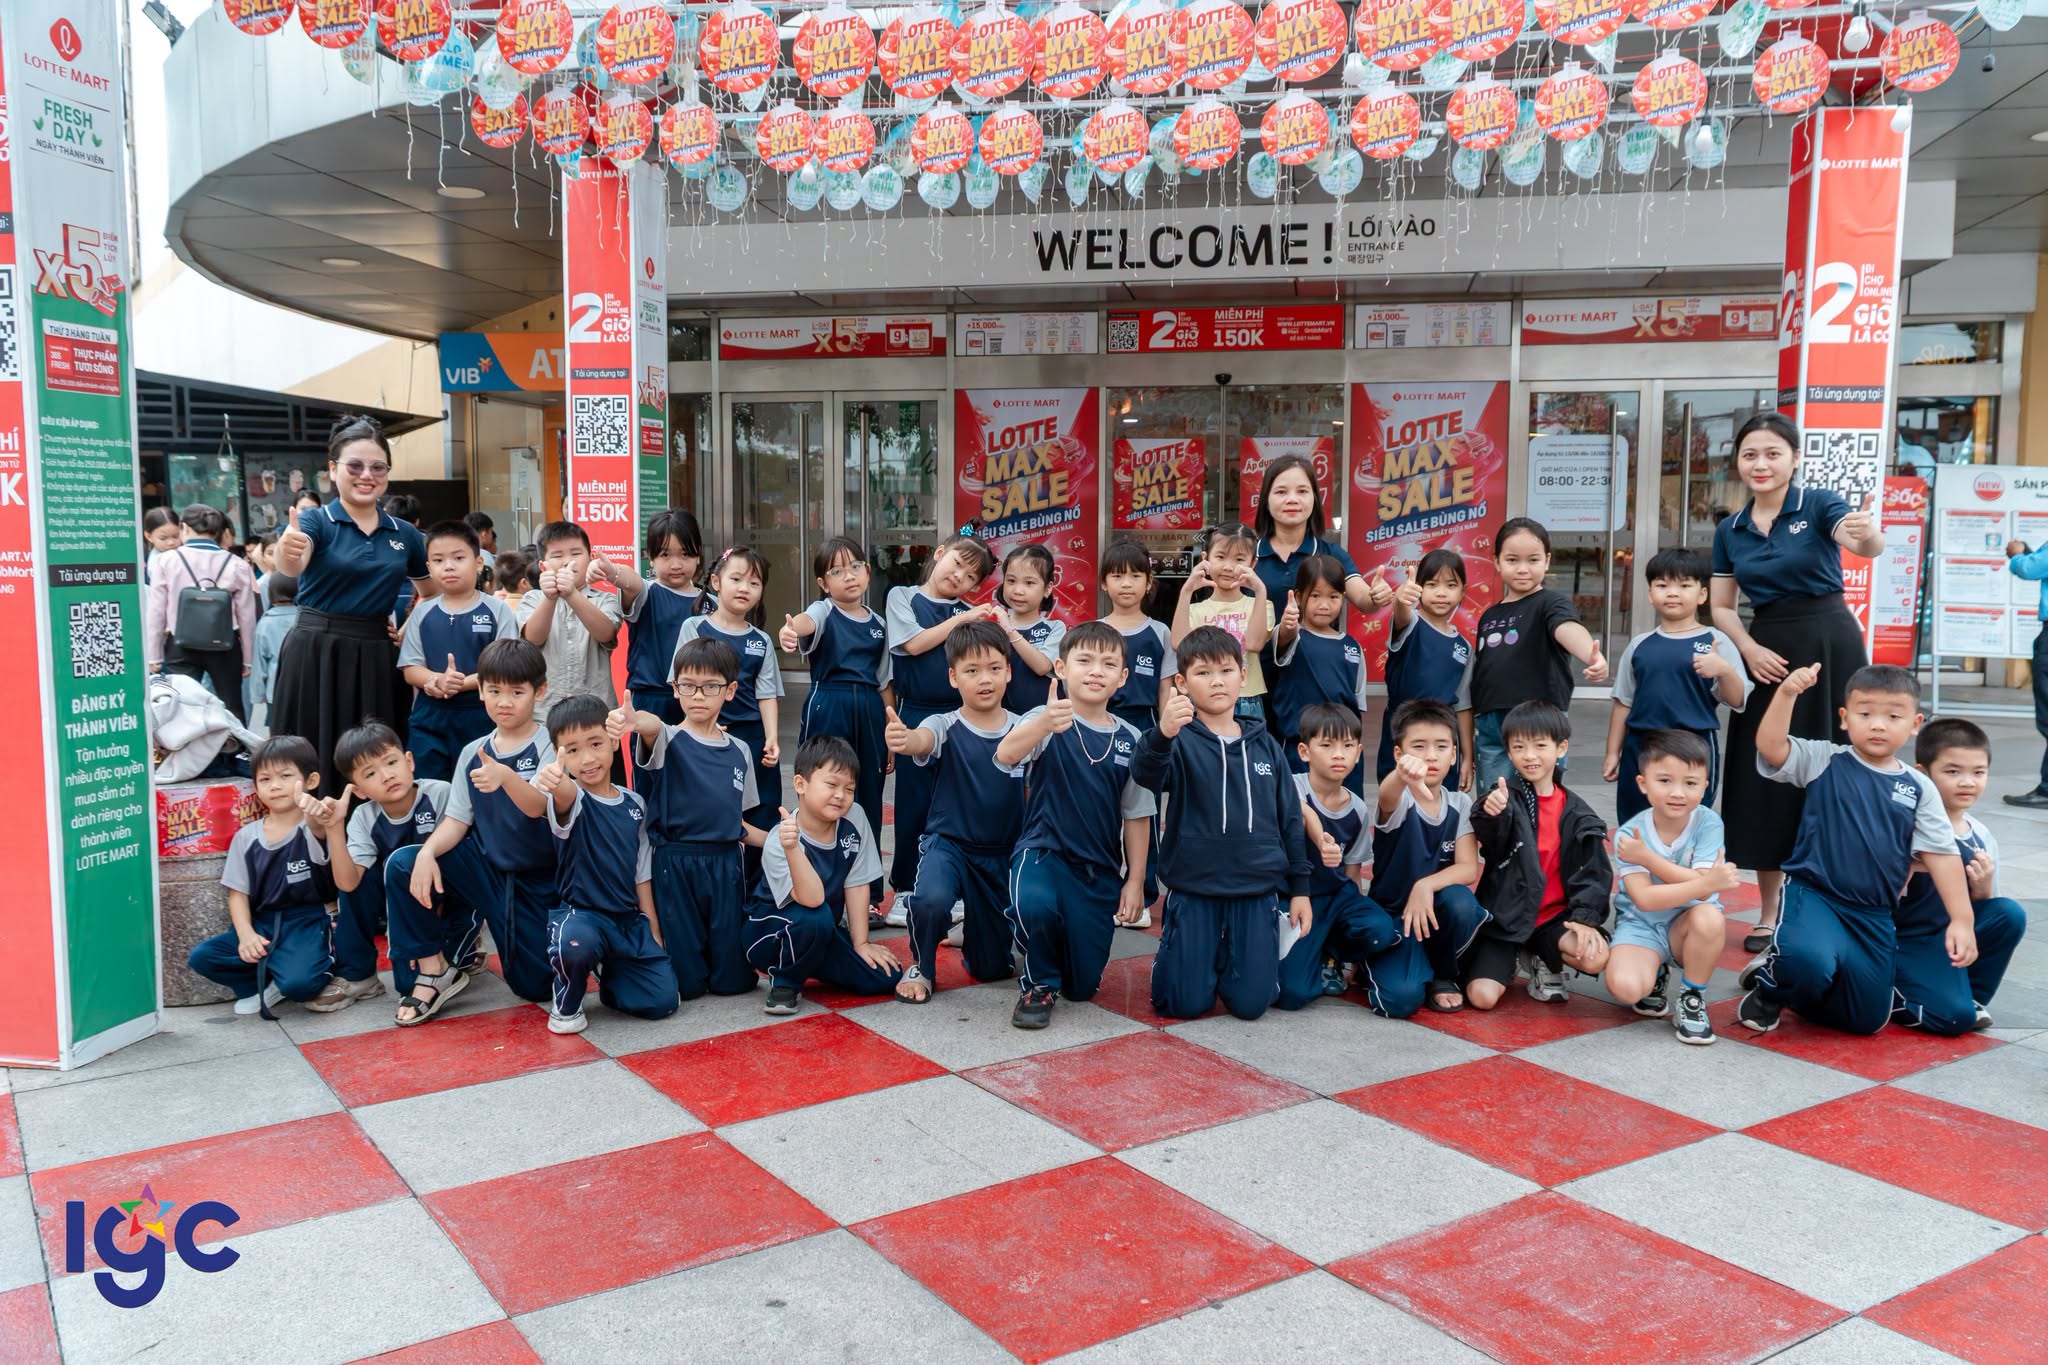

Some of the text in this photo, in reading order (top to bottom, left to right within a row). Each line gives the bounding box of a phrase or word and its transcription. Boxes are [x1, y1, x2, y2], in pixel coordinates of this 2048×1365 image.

[617, 6, 657, 26] LOTTE
[1047, 15, 1091, 38] LOTTE
[1189, 6, 1233, 30] LOTTE
[616, 19, 654, 44] MAX
[1045, 29, 1089, 58] MAX
[1187, 20, 1232, 49] MAX
[1900, 23, 1938, 43] LOTTE
[615, 36, 660, 63] SALE
[1187, 36, 1239, 68] SALE
[1899, 35, 1937, 59] MAX
[24, 52, 109, 92] LOTTE MART
[1045, 46, 1095, 77] SALE
[1899, 49, 1944, 74] SALE
[1553, 75, 1589, 94] LOTTE
[1552, 86, 1588, 108] MAX
[44, 99, 93, 129] FRESH
[1552, 100, 1594, 124] SALE
[53, 122, 86, 146] DAY
[1831, 157, 1903, 169] LOTTE MART
[1348, 241, 1405, 252] ENTRANCE
[1865, 274, 1885, 286] CHỢ
[1215, 306, 1264, 320] MIỄN PHÍ
[1809, 262, 1858, 344] 2
[569, 292, 603, 344] 2
[1539, 311, 1619, 323] LOTTE MART
[1730, 314, 1740, 325] 9
[734, 329, 800, 339] LOTTE MART
[894, 330, 902, 342] 9
[1149, 311, 1177, 348] 2
[1213, 329, 1265, 347] 150K
[446, 367, 480, 385] VIB
[529, 349, 566, 379] AT
[1003, 399, 1060, 408] LOTTE MART
[1403, 392, 1466, 401] LOTTE MART
[1809, 387, 1823, 400] Tải
[1843, 387, 1863, 401] dụng
[988, 416, 1058, 453] LOTTE
[1386, 410, 1463, 450] LOTTE
[985, 442, 1053, 486] MAX
[1132, 442, 1185, 469] LOTTE
[1383, 437, 1457, 483] MAX
[1133, 460, 1182, 488] MAX
[1539, 476, 1574, 486] 08:00
[1978, 481, 2001, 489] NEW
[578, 479, 627, 494] MIỄN PHÍ
[982, 470, 1069, 522] SALE
[1132, 477, 1190, 511] SALE
[1378, 466, 1475, 522] SALE
[578, 503, 629, 523] 150K
[999, 520, 1028, 538] SALE
[1029, 510, 1061, 530] BÙNG
[1126, 501, 1183, 523] SIÊU SALE BÙNG
[1366, 526, 1394, 544] SIÊU
[1396, 518, 1429, 536] SALE
[1430, 510, 1466, 529] BÙNG
[58, 568, 73, 582] Tải
[74, 570, 91, 584] ứng
[92, 569, 114, 583] dụng
[72, 689, 127, 715] ĐĂNG KÝ
[65, 714, 138, 740] THÀNH VIÊN
[75, 743, 130, 764] Tận hưởng
[65, 759, 145, 788] nhiều đặc quyền
[74, 791, 97, 807] mua
[97, 785, 118, 802] sắm
[71, 803, 143, 830] dành riêng cho
[167, 808, 201, 827] MAX
[80, 826, 132, 849] thành viên
[167, 818, 207, 841] SALE
[76, 843, 140, 872] LOTTE MART
